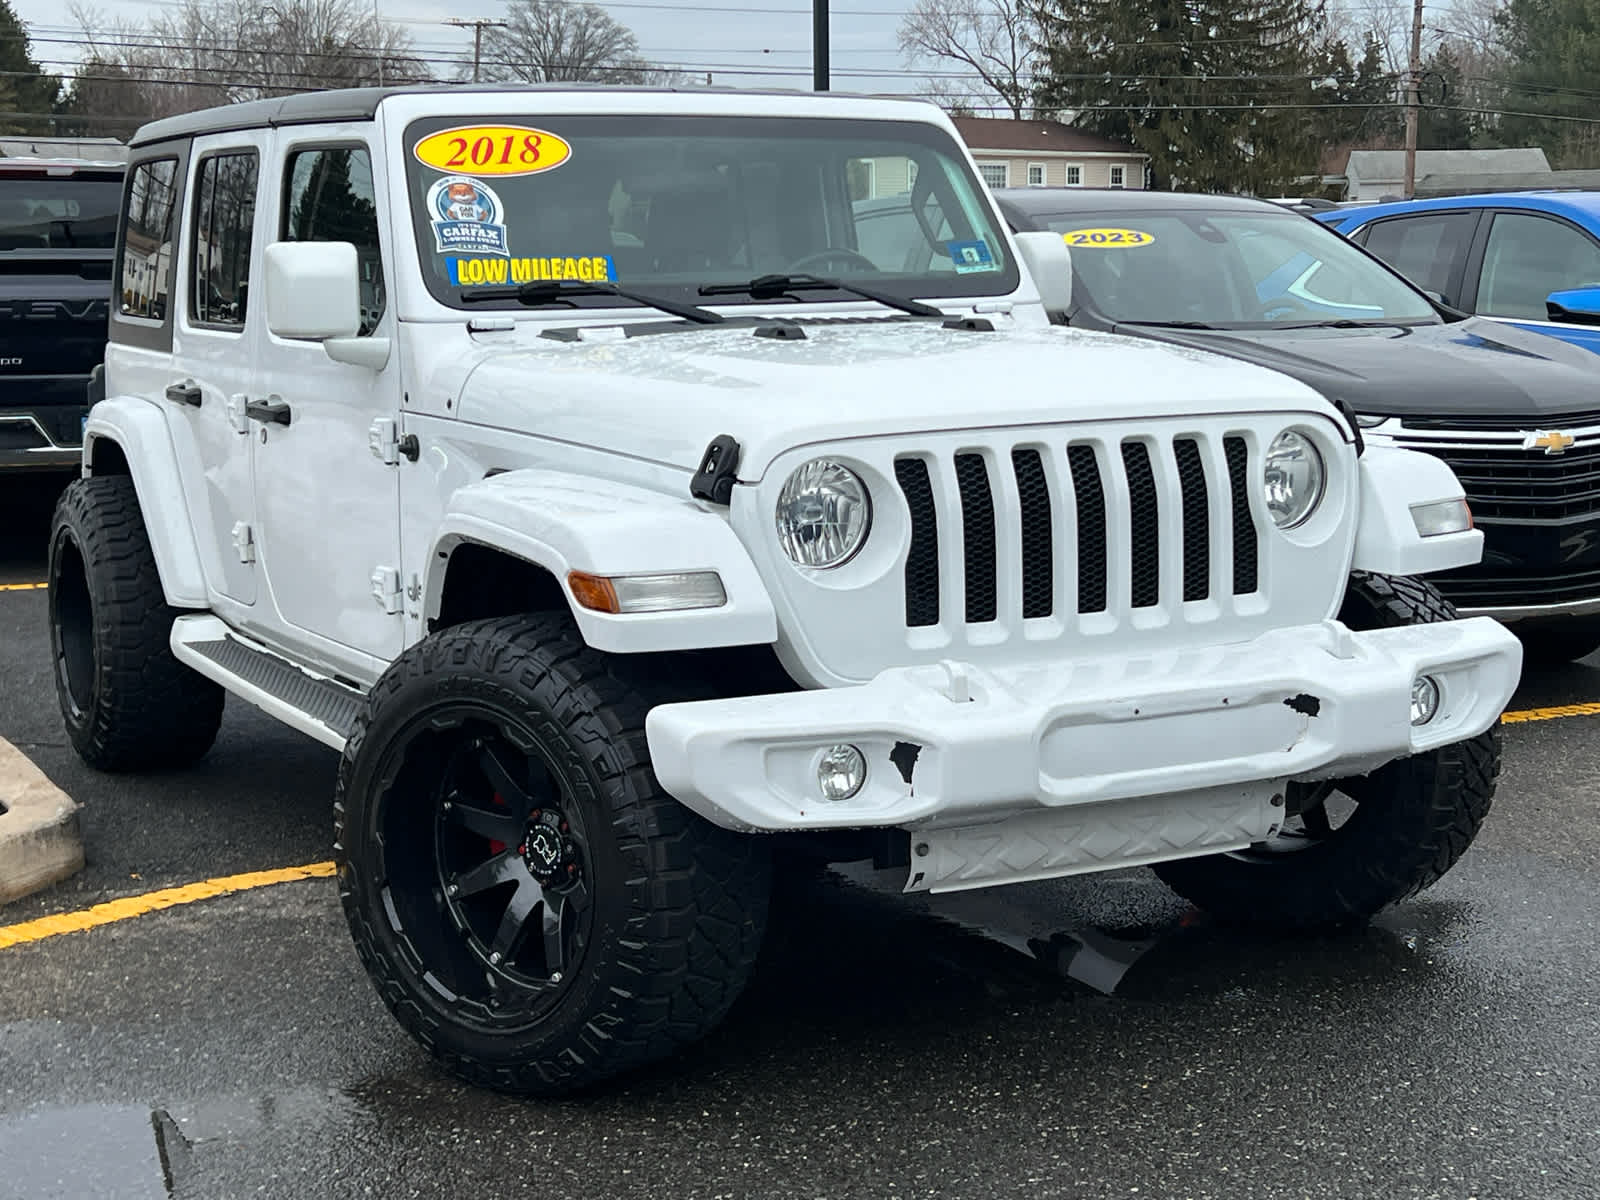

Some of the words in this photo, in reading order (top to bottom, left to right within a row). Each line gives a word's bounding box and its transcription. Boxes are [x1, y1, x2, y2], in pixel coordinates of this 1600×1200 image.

[445, 134, 542, 167] 2018
[442, 227, 499, 240] CARFAX
[1070, 232, 1146, 245] 2023
[457, 258, 508, 285] LOW
[510, 256, 608, 283] MILEAGE
